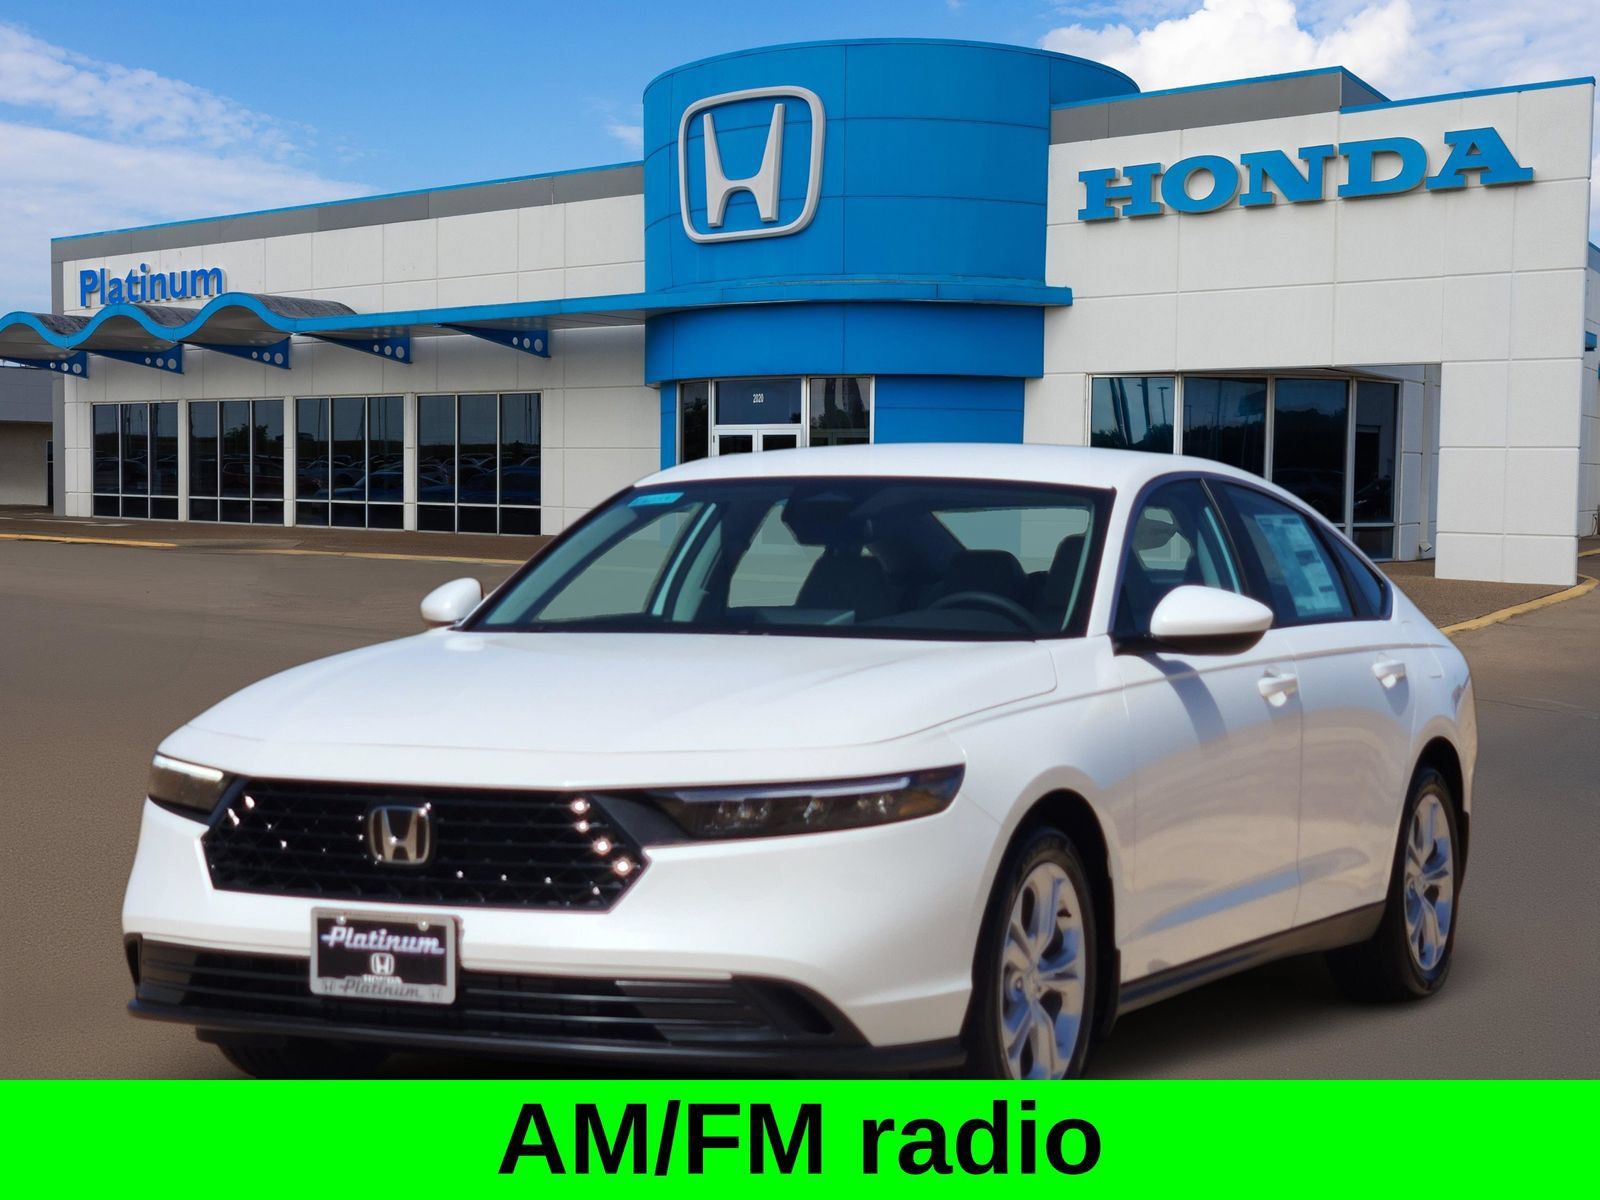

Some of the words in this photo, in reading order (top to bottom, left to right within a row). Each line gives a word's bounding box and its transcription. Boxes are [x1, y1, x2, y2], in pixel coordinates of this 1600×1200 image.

[1077, 126, 1534, 222] HONDA
[79, 262, 224, 307] Platinum
[320, 926, 446, 955] Platinum
[339, 978, 421, 998] Platinum
